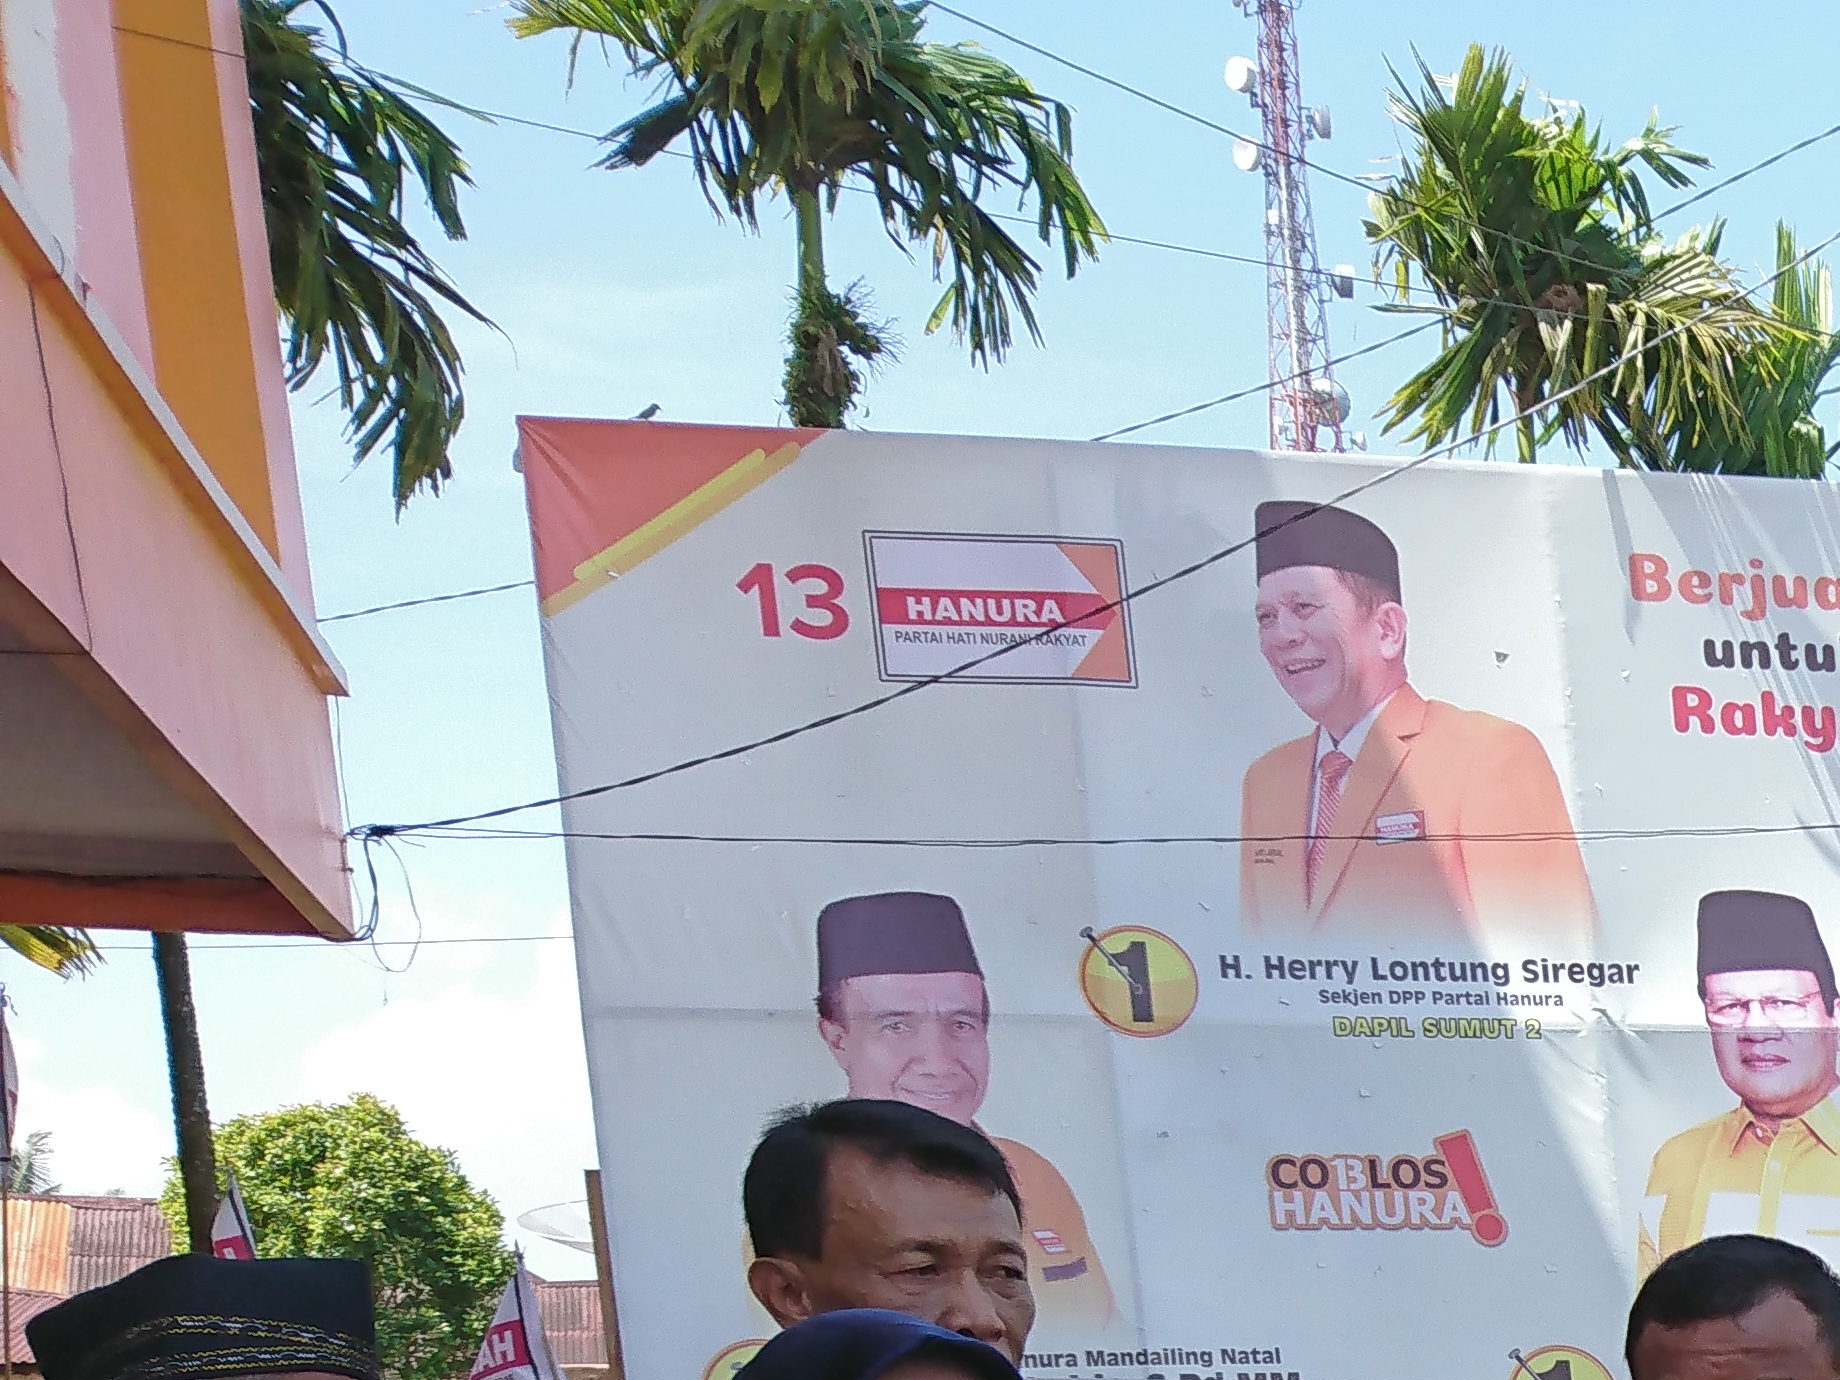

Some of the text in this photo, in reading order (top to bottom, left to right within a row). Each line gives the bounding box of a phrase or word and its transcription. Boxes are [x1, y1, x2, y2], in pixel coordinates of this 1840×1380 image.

[734, 561, 850, 641] 13
[906, 595, 1066, 623] HANURA
[894, 630, 1087, 647] PARTAI HATI NURANI RAKYAT
[1107, 941, 1154, 1023] 1
[1219, 954, 1641, 990] H. Herry Lontung Siregar
[1318, 988, 1384, 1007] Sekjen
[1389, 989, 1426, 1005] DPP
[1496, 991, 1564, 1007] Hanura
[1332, 1015, 1543, 1040] DAPIL SUMUT 2
[1086, 1347, 1213, 1368] Mandailing
[1220, 1347, 1282, 1366] Natal
